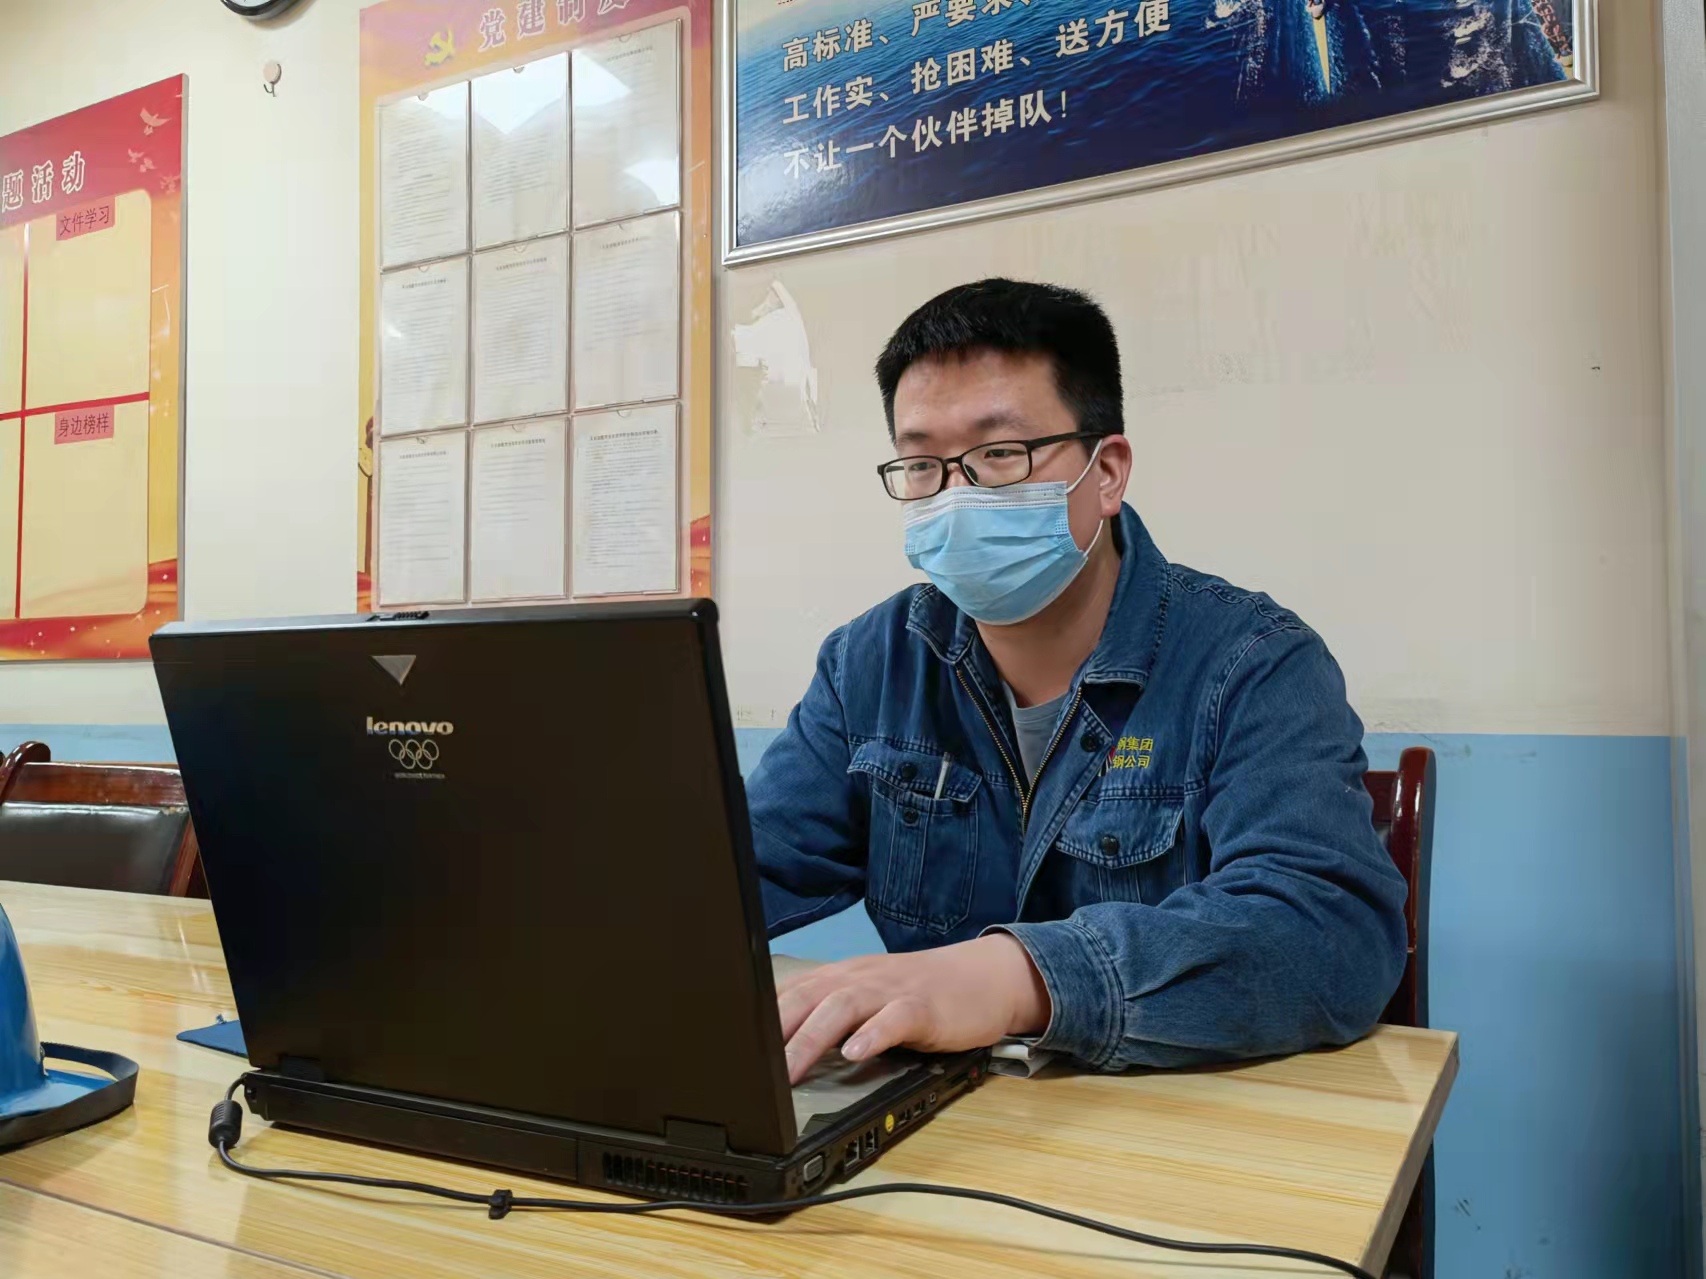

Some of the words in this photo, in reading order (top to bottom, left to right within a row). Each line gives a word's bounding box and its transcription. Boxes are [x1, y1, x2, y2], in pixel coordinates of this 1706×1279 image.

[60, 206, 110, 236] 文件学习
[57, 412, 109, 437] 身边榜样
[366, 716, 454, 735] lenovo
